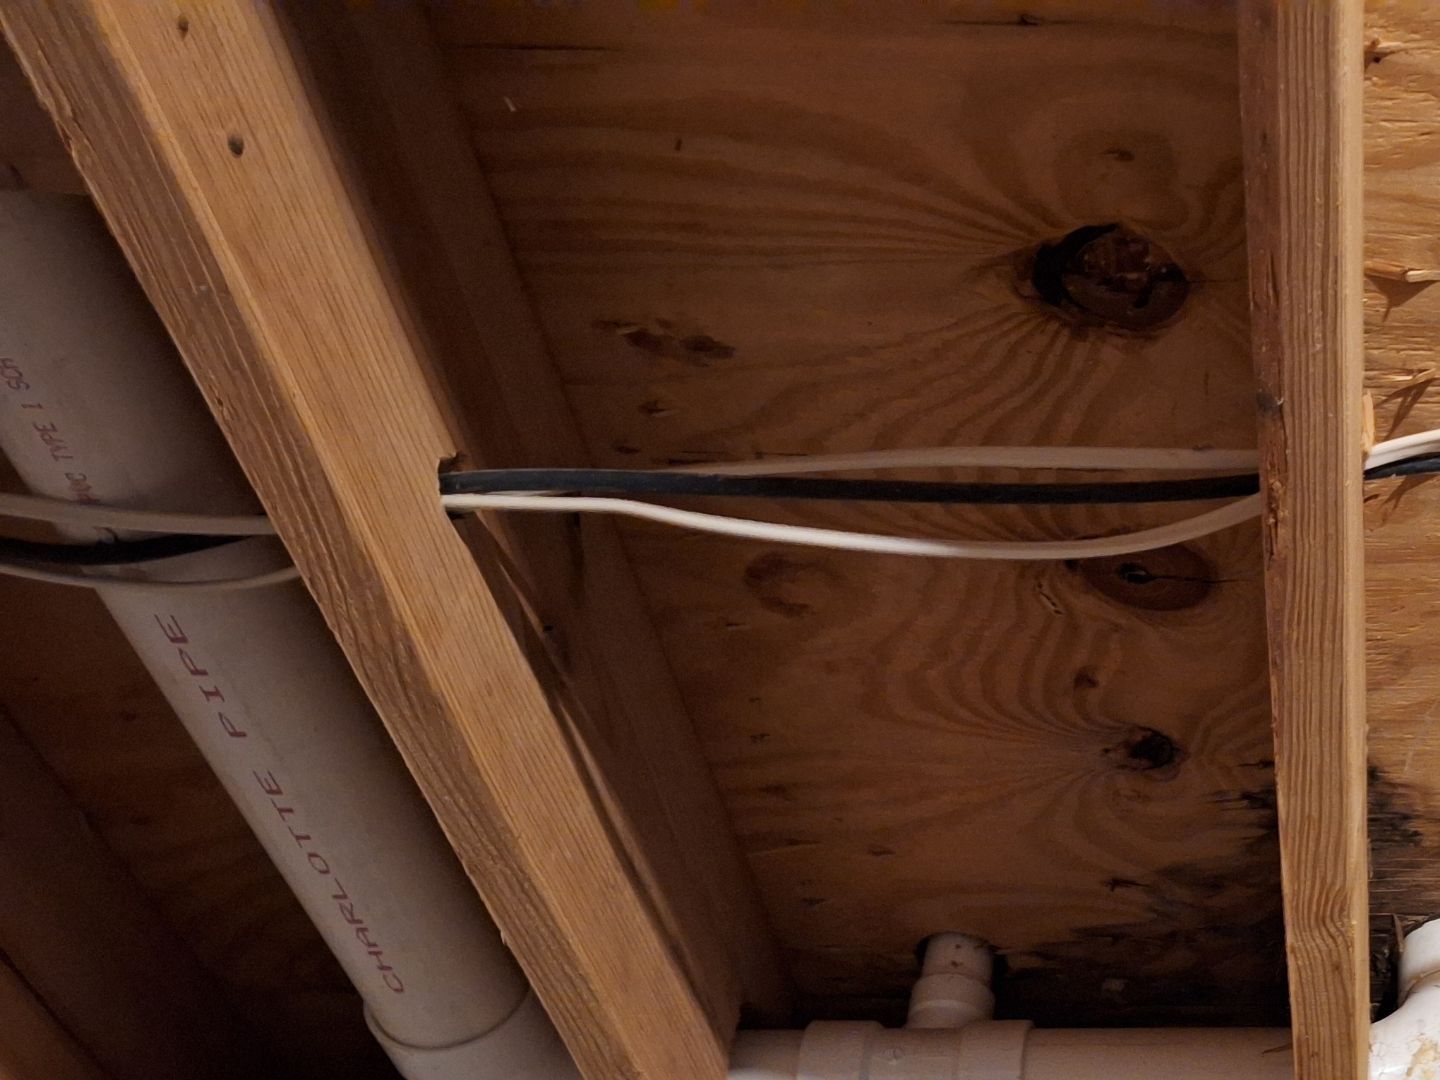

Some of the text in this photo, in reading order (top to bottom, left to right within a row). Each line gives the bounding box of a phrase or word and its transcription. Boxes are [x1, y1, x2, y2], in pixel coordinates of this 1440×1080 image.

[32, 421, 74, 462] TYPE
[154, 613, 404, 994] CHARLOTTE PIPE
